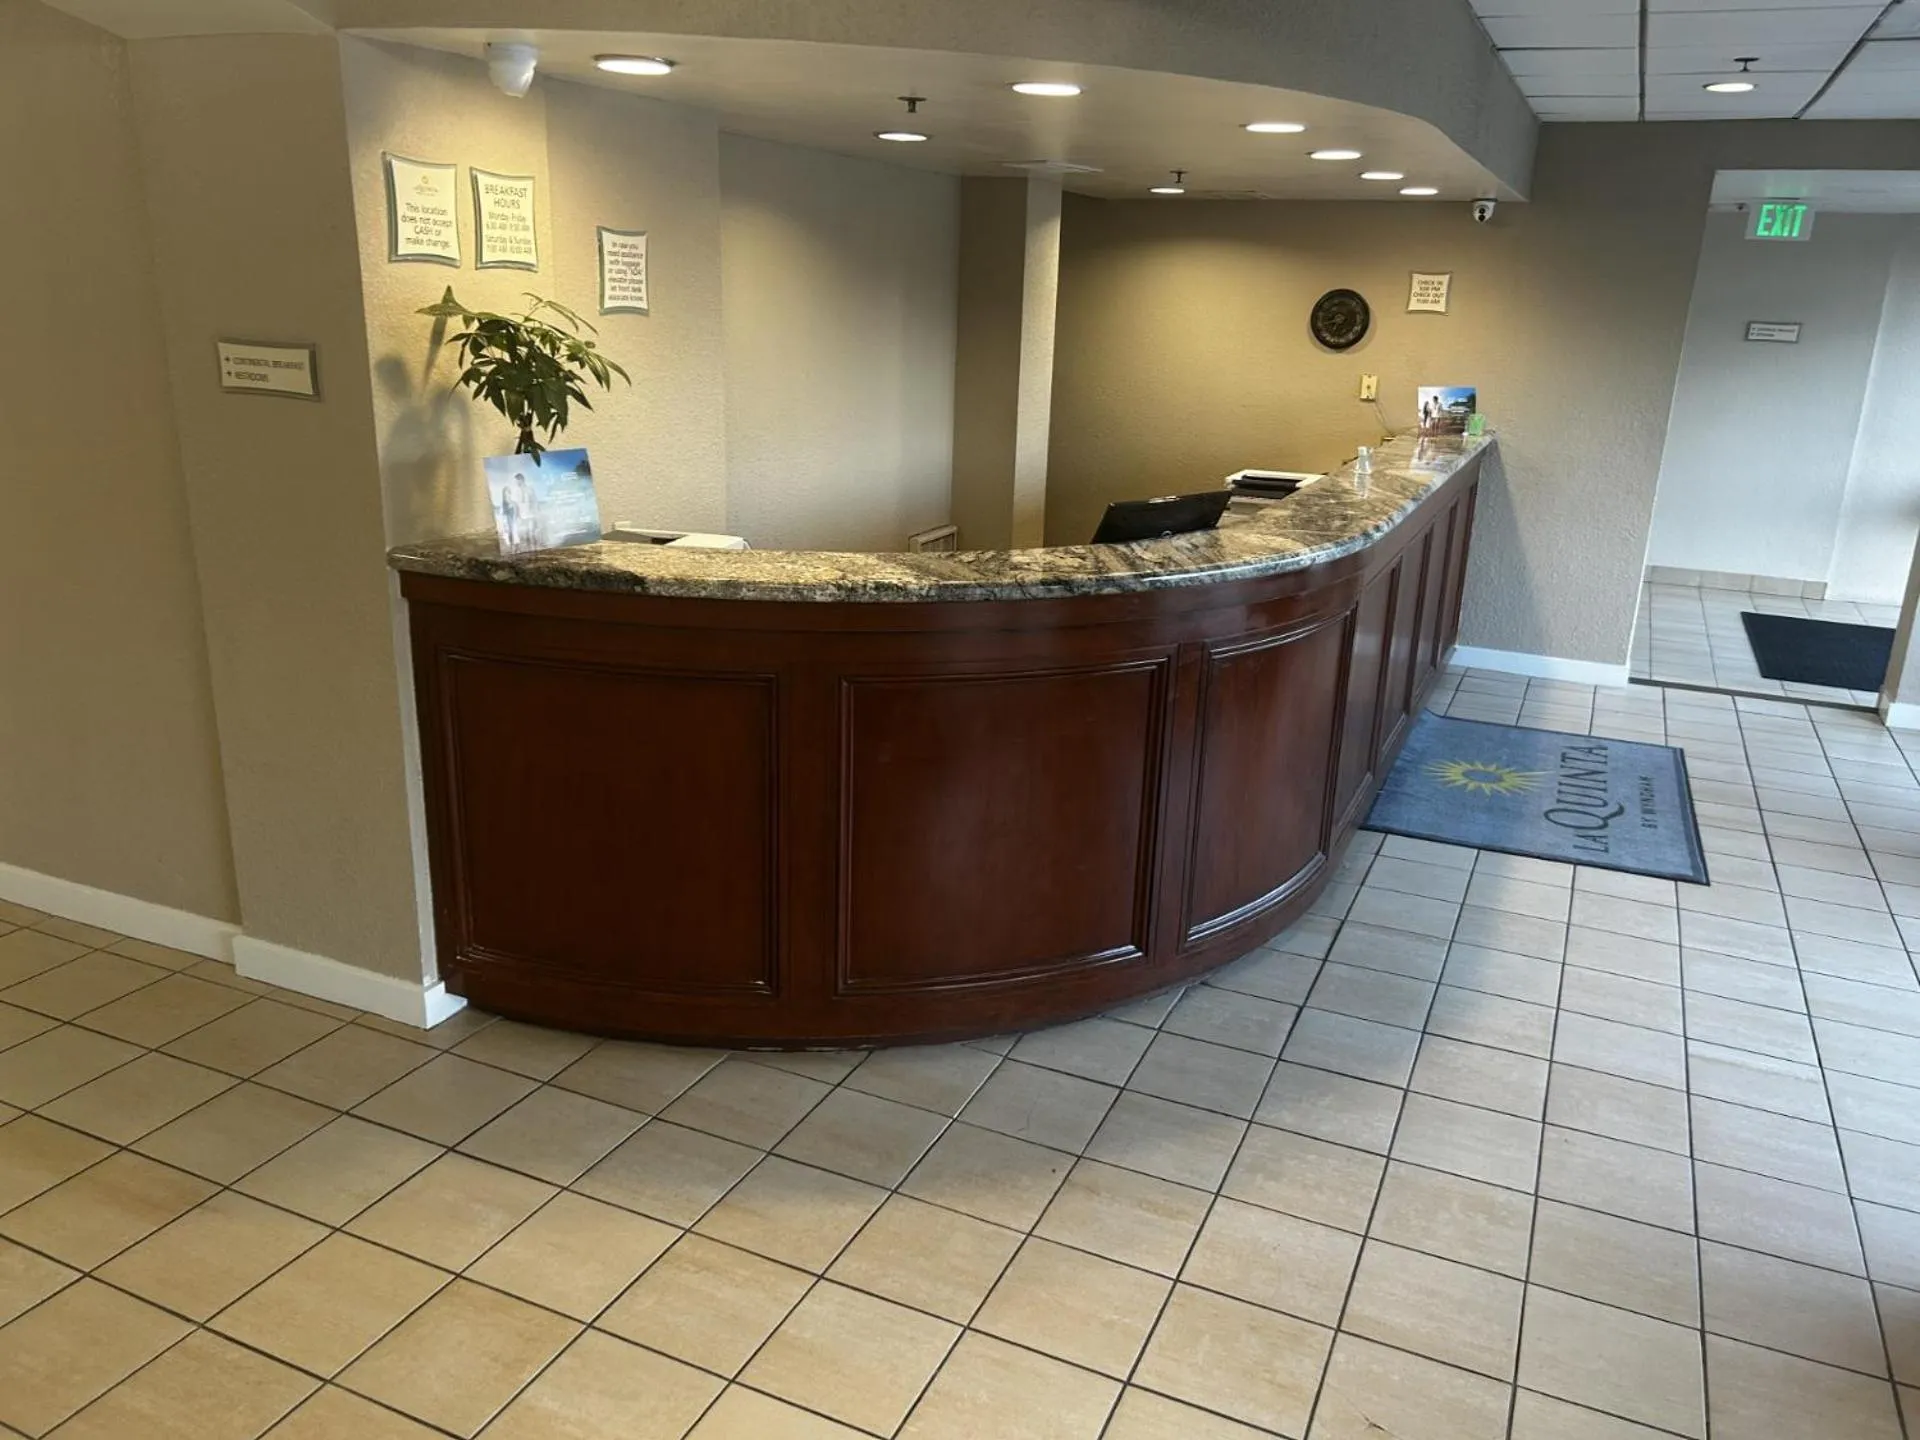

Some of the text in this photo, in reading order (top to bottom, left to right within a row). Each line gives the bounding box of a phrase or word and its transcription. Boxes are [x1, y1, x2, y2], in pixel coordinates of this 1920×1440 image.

[484, 184, 528, 199] BREAKFAST
[493, 199, 520, 209] HOURS
[1756, 204, 1808, 237] EXIT
[414, 225, 433, 235] CASH
[1543, 745, 1625, 853] LA QUINTA
[1640, 816, 1658, 830] BY
